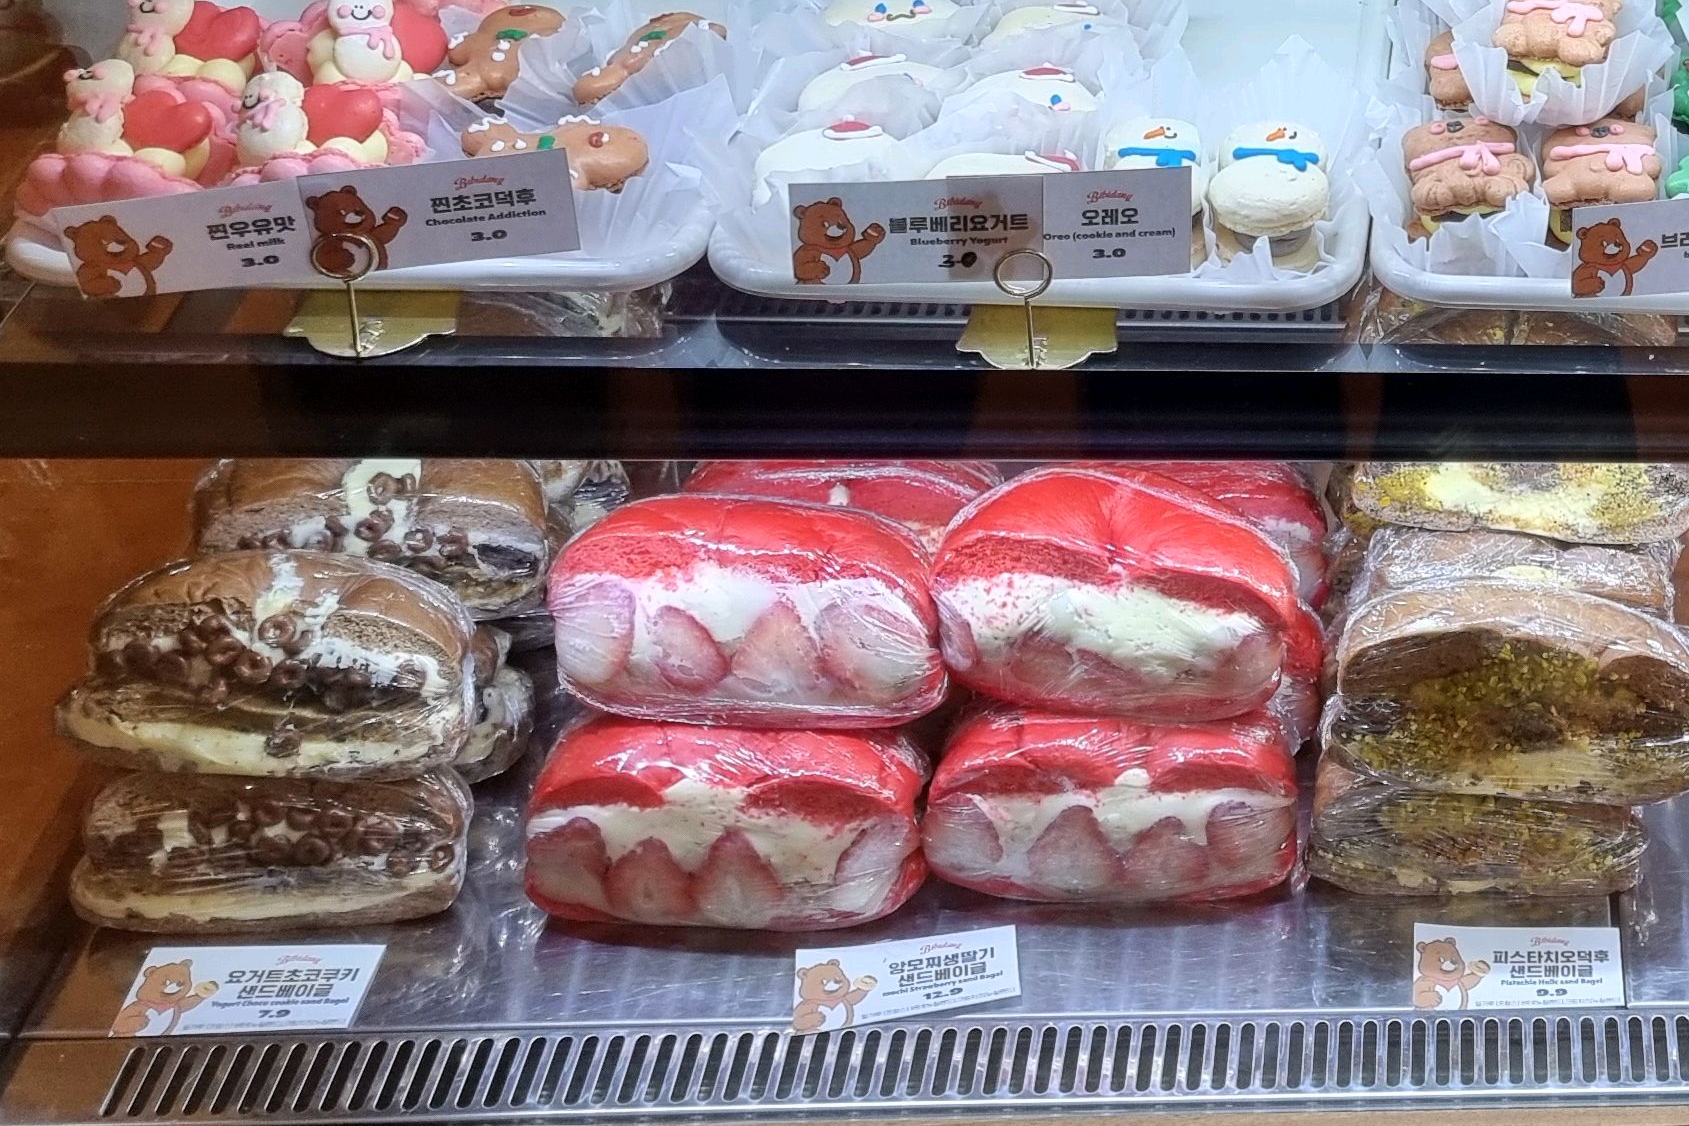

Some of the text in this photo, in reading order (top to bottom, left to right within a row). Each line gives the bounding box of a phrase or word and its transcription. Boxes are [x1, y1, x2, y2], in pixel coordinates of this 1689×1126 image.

[430, 188, 536, 214] 찐초코덕후
[425, 209, 546, 227] Chocolate Addiction
[889, 213, 1029, 234] 블루베리요거트
[1081, 207, 1139, 226] 오레오
[206, 215, 296, 240] 찐우유맛
[1043, 227, 1176, 242] Oreo (cookie and cream)
[471, 229, 508, 242] 3.0
[910, 236, 1009, 247] Blueberry Yogurt
[226, 240, 255, 250] Real
[241, 255, 280, 267] 3.0
[1092, 248, 1126, 259] 3.0
[888, 946, 995, 975] 앙모찌생딸기
[1493, 950, 1610, 965] 피스타치오덕후
[224, 967, 360, 984] 요거트초코쿠키
[898, 960, 987, 987] 샌드베이글
[1509, 964, 1594, 979] 샌드베이글
[237, 983, 335, 1000] 샌드베이글
[922, 987, 964, 1000] 12.9
[1536, 988, 1568, 997] 9.9
[258, 1009, 291, 1019] 7.9
